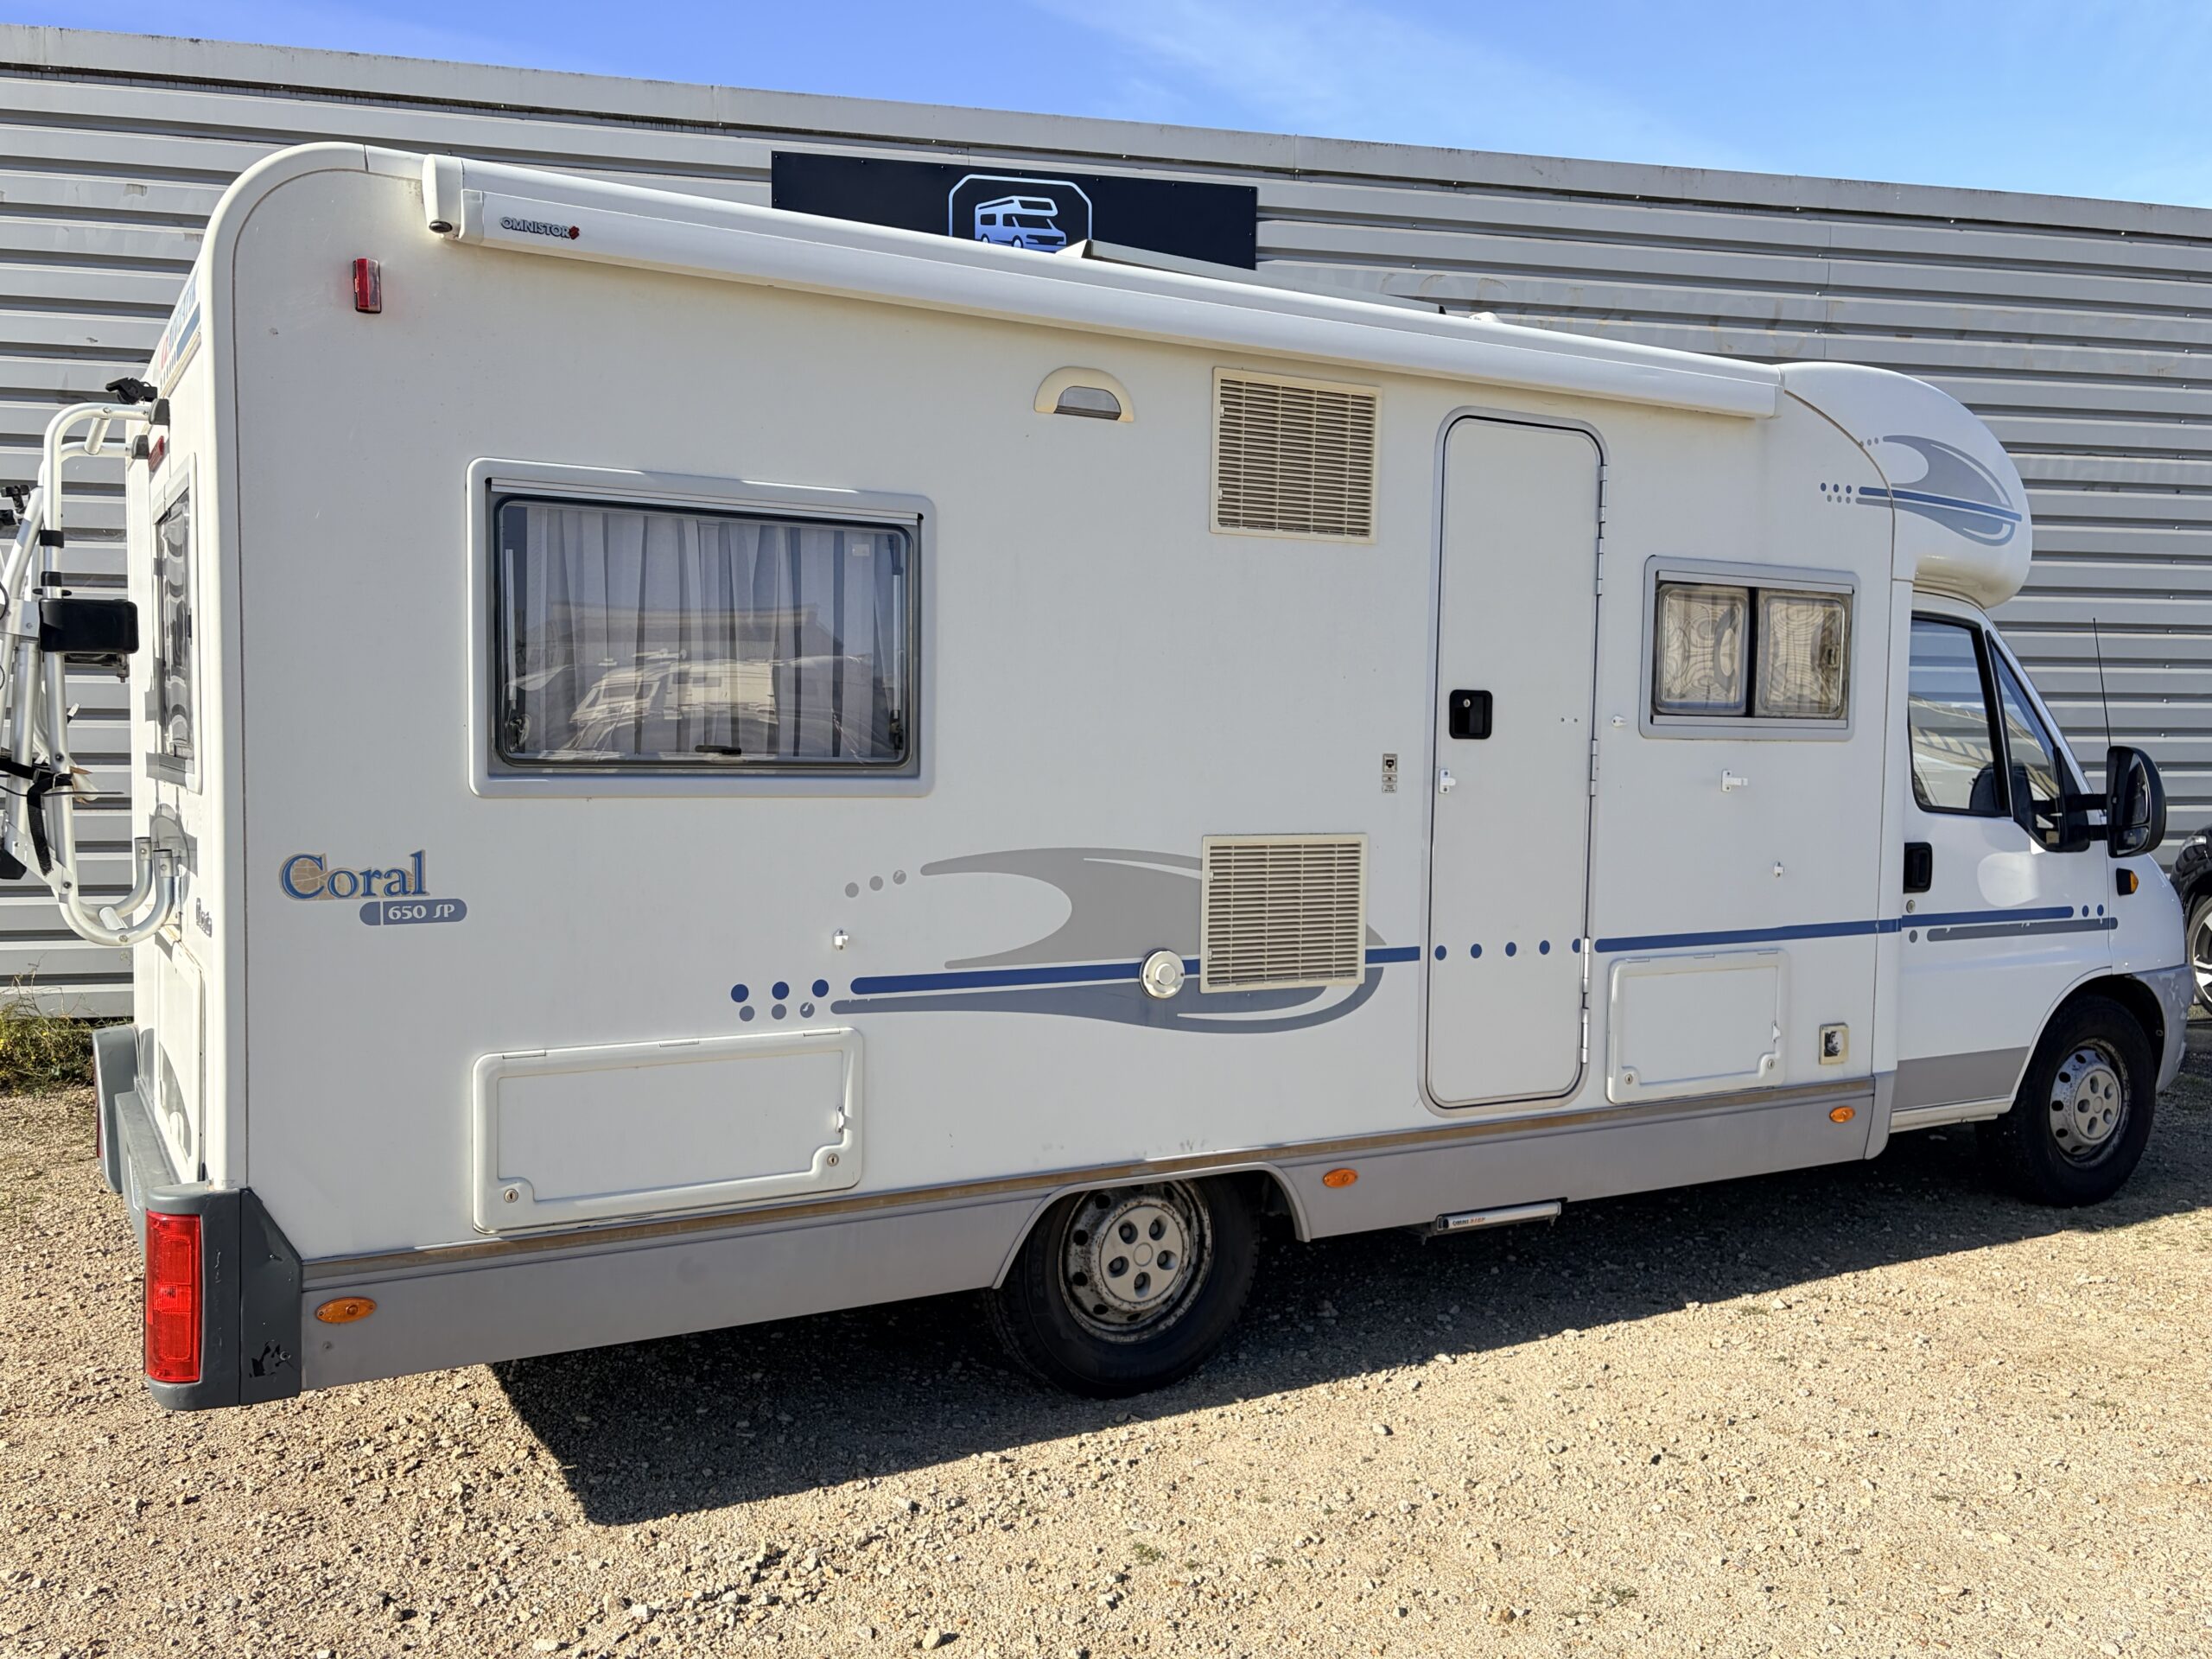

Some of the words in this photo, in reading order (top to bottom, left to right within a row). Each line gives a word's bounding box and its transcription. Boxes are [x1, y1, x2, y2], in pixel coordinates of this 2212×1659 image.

[499, 216, 570, 238] OMNISTOR
[279, 849, 429, 900] Coral
[388, 905, 426, 920] 650
[433, 904, 455, 918] SP
